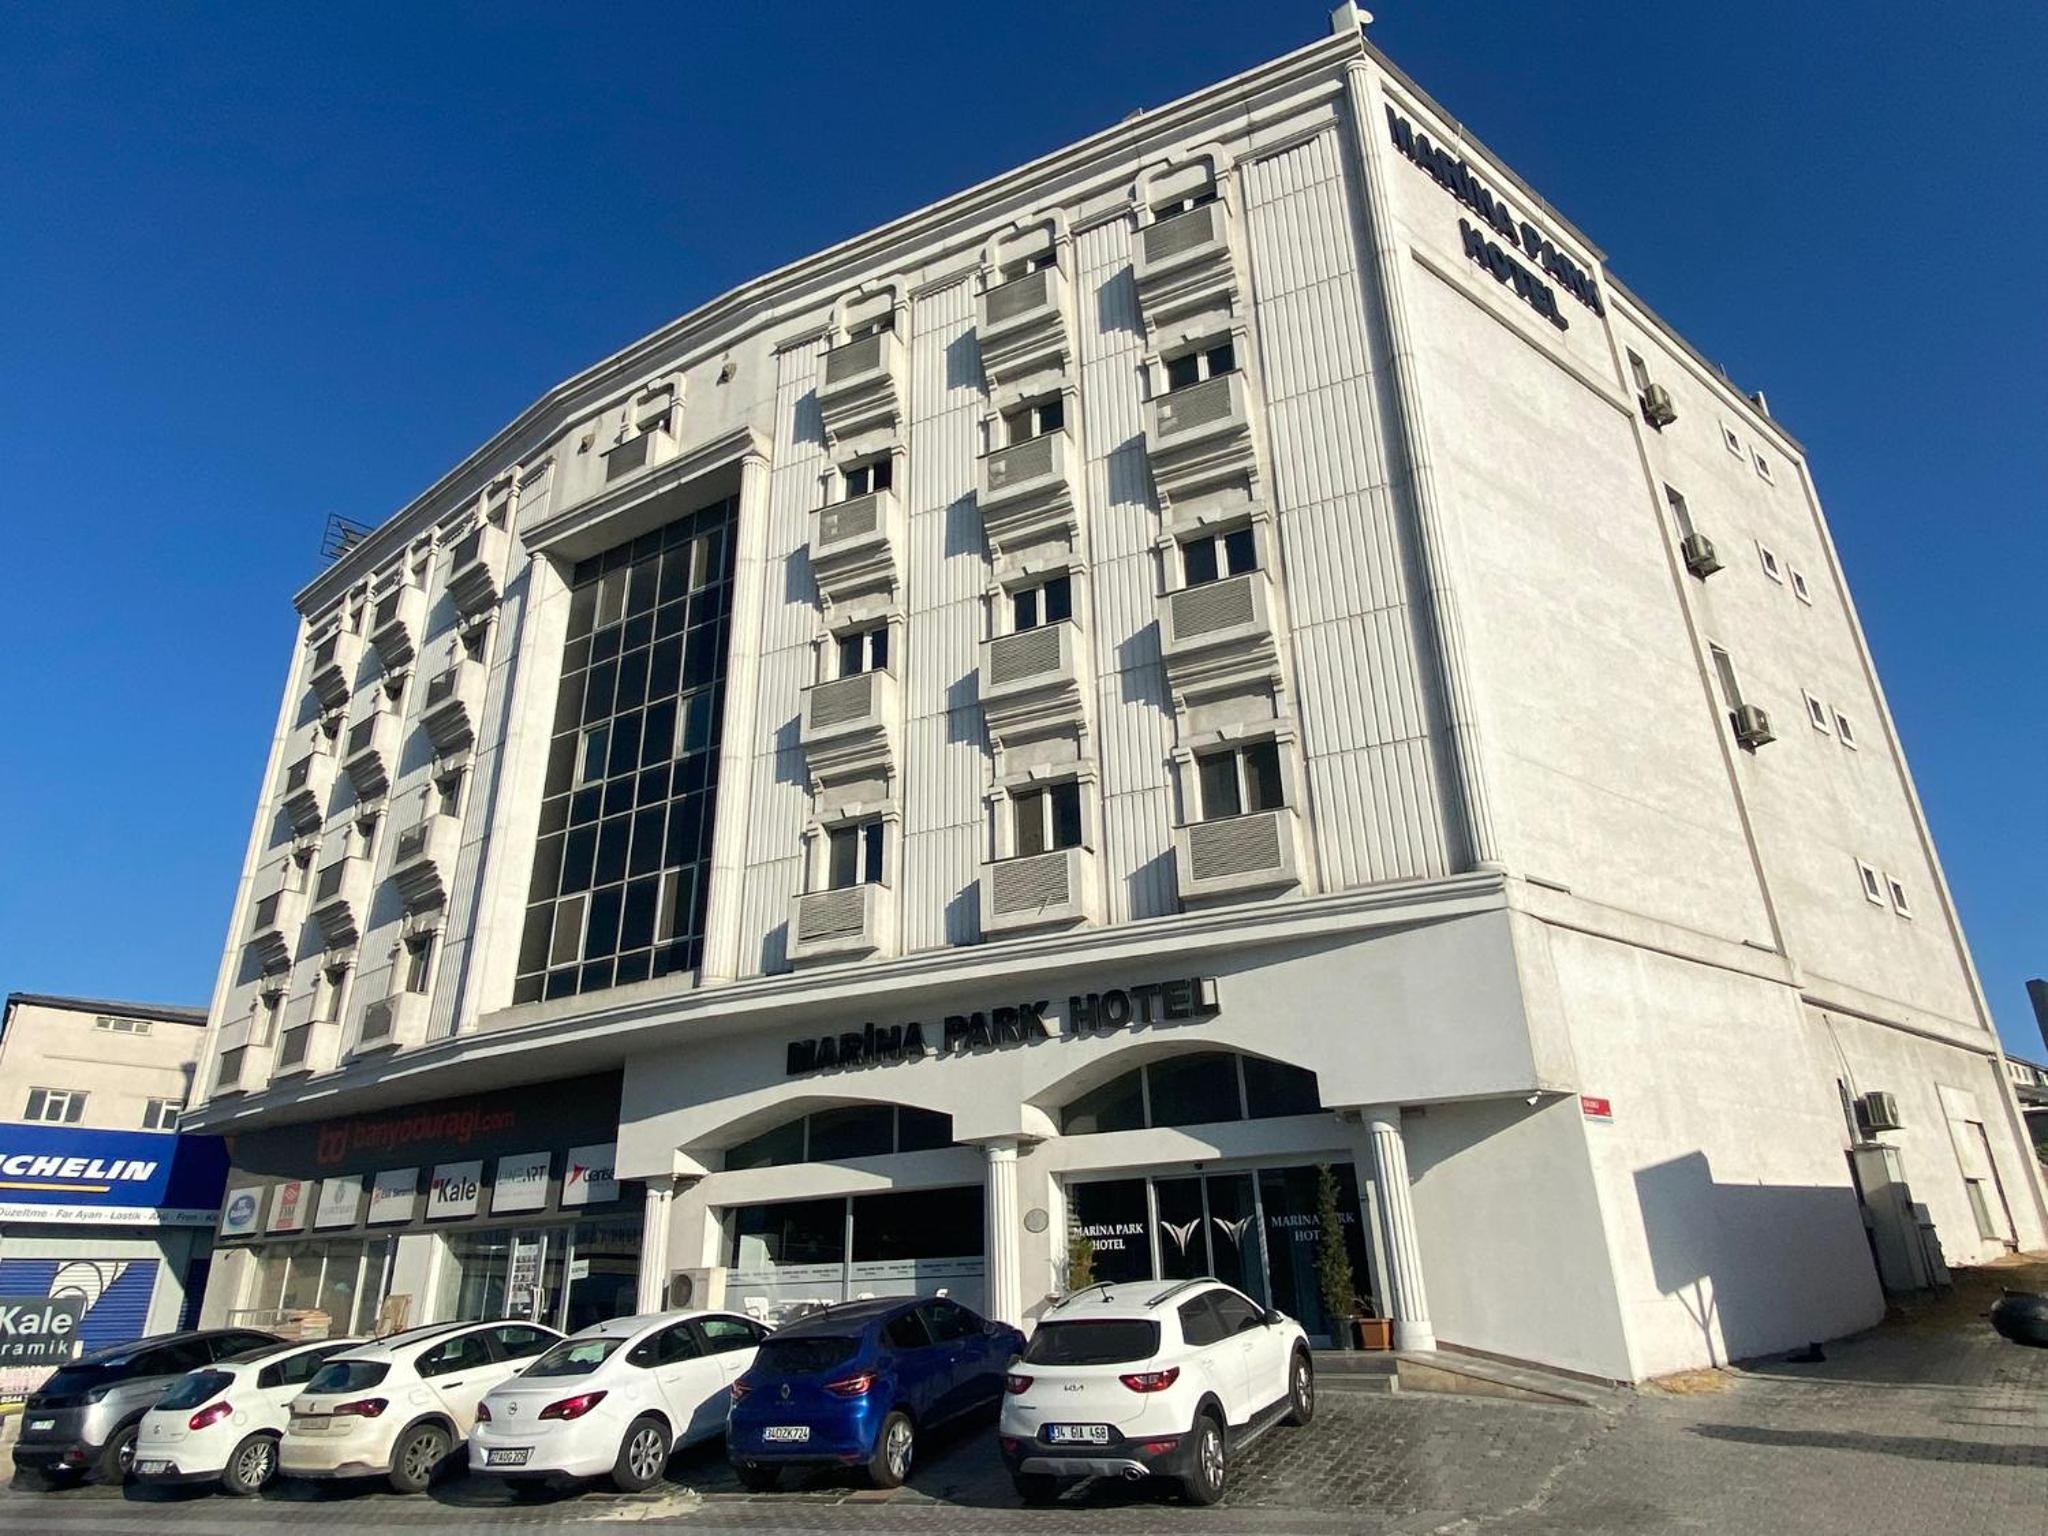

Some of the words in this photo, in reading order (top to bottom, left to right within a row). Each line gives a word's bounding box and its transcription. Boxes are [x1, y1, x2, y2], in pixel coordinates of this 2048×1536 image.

[1457, 217, 1570, 332] HOTEL
[1519, 221, 1606, 319] PARK
[943, 1000, 1053, 1052] PARK
[1068, 977, 1221, 1031] HOTEL
[438, 1176, 478, 1203] Kale
[1116, 1222, 1144, 1235] PARK
[1092, 1238, 1126, 1250] HOTEL
[0, 1306, 74, 1335] Kale
